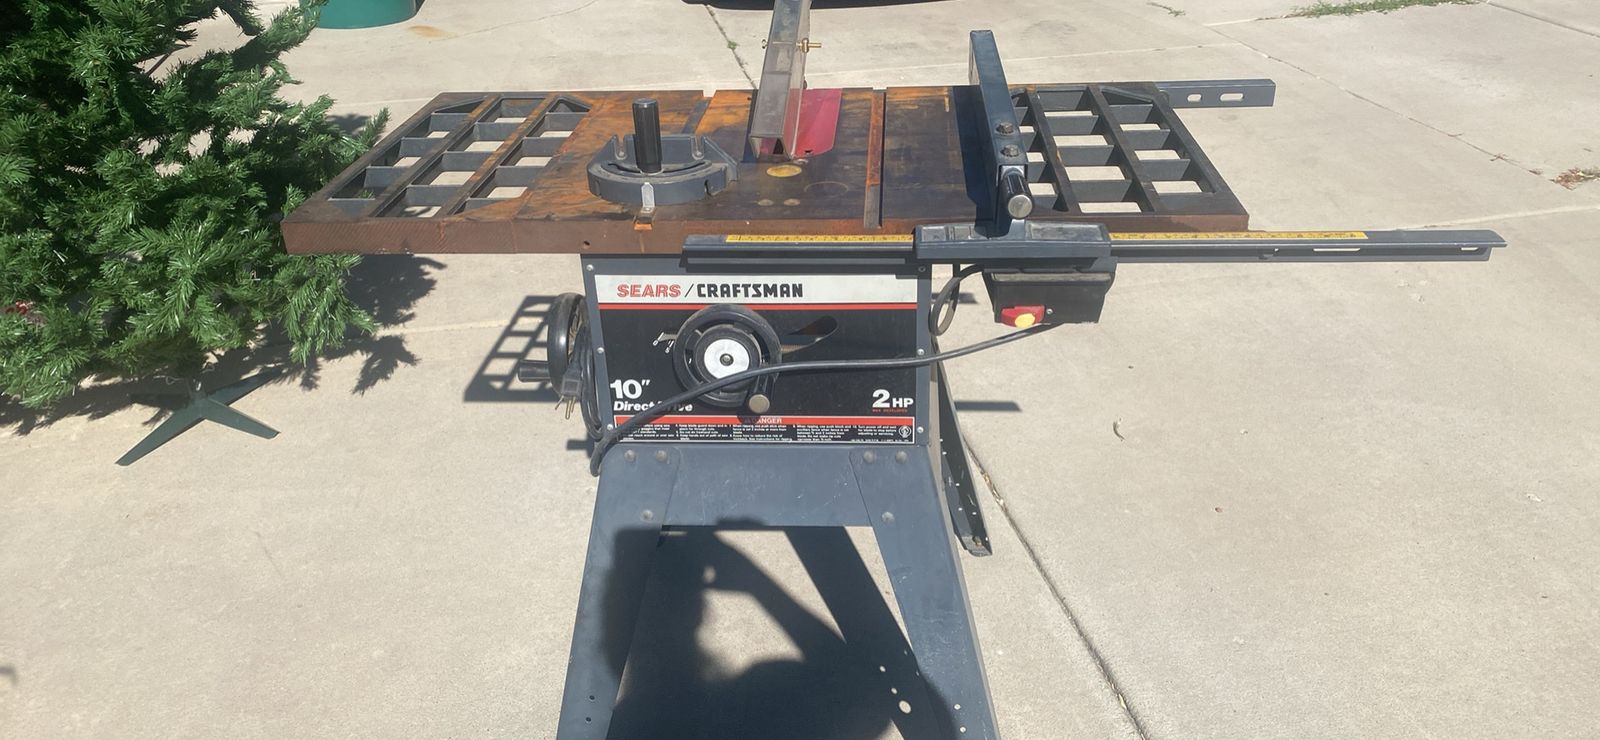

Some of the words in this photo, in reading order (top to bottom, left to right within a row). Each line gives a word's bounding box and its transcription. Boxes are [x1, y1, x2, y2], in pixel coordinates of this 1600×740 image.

[617, 284, 681, 297] SEARS
[697, 284, 803, 298] CRAFTSMAN
[872, 389, 890, 408] 2
[892, 398, 914, 408] HP
[613, 400, 655, 412] Direct
